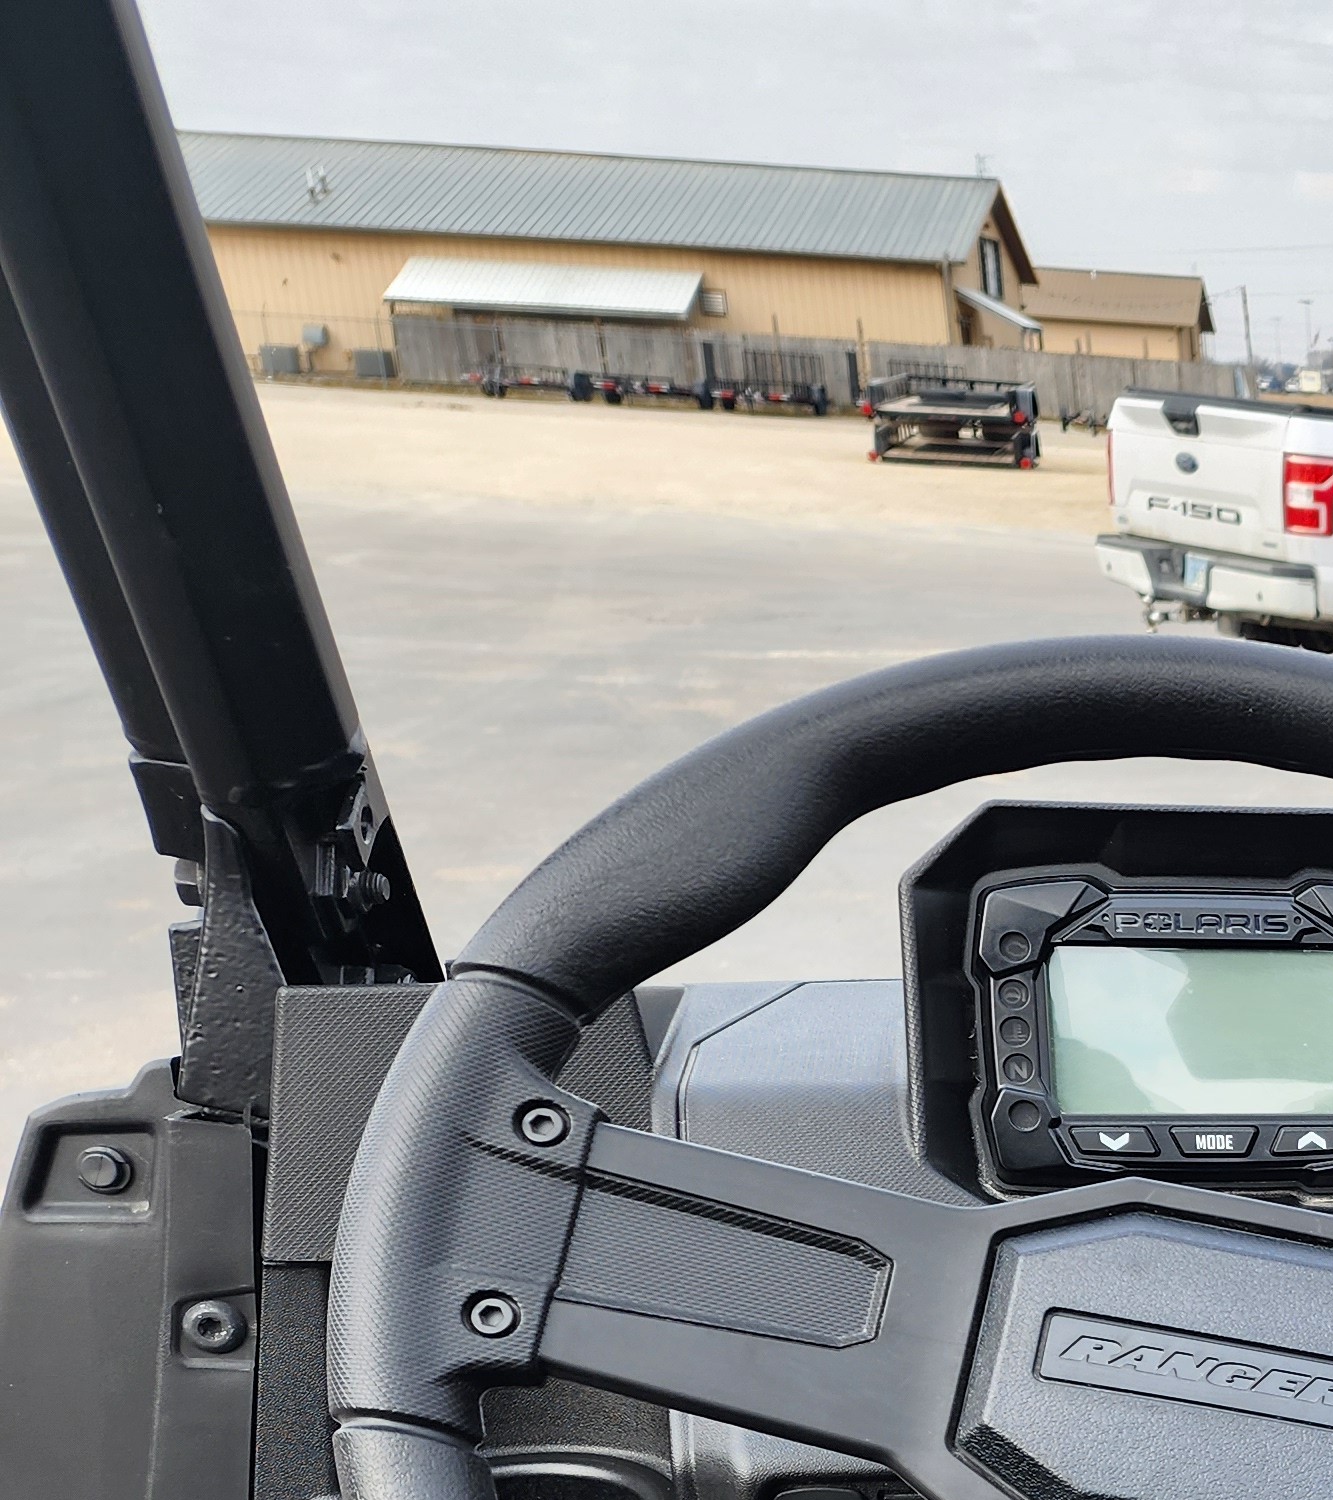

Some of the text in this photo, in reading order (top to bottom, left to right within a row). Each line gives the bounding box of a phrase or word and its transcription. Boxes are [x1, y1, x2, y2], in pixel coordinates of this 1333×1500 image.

[1114, 912, 1289, 935] POLARIS
[1009, 1061, 1028, 1080] N
[1195, 1134, 1234, 1151] MODE
